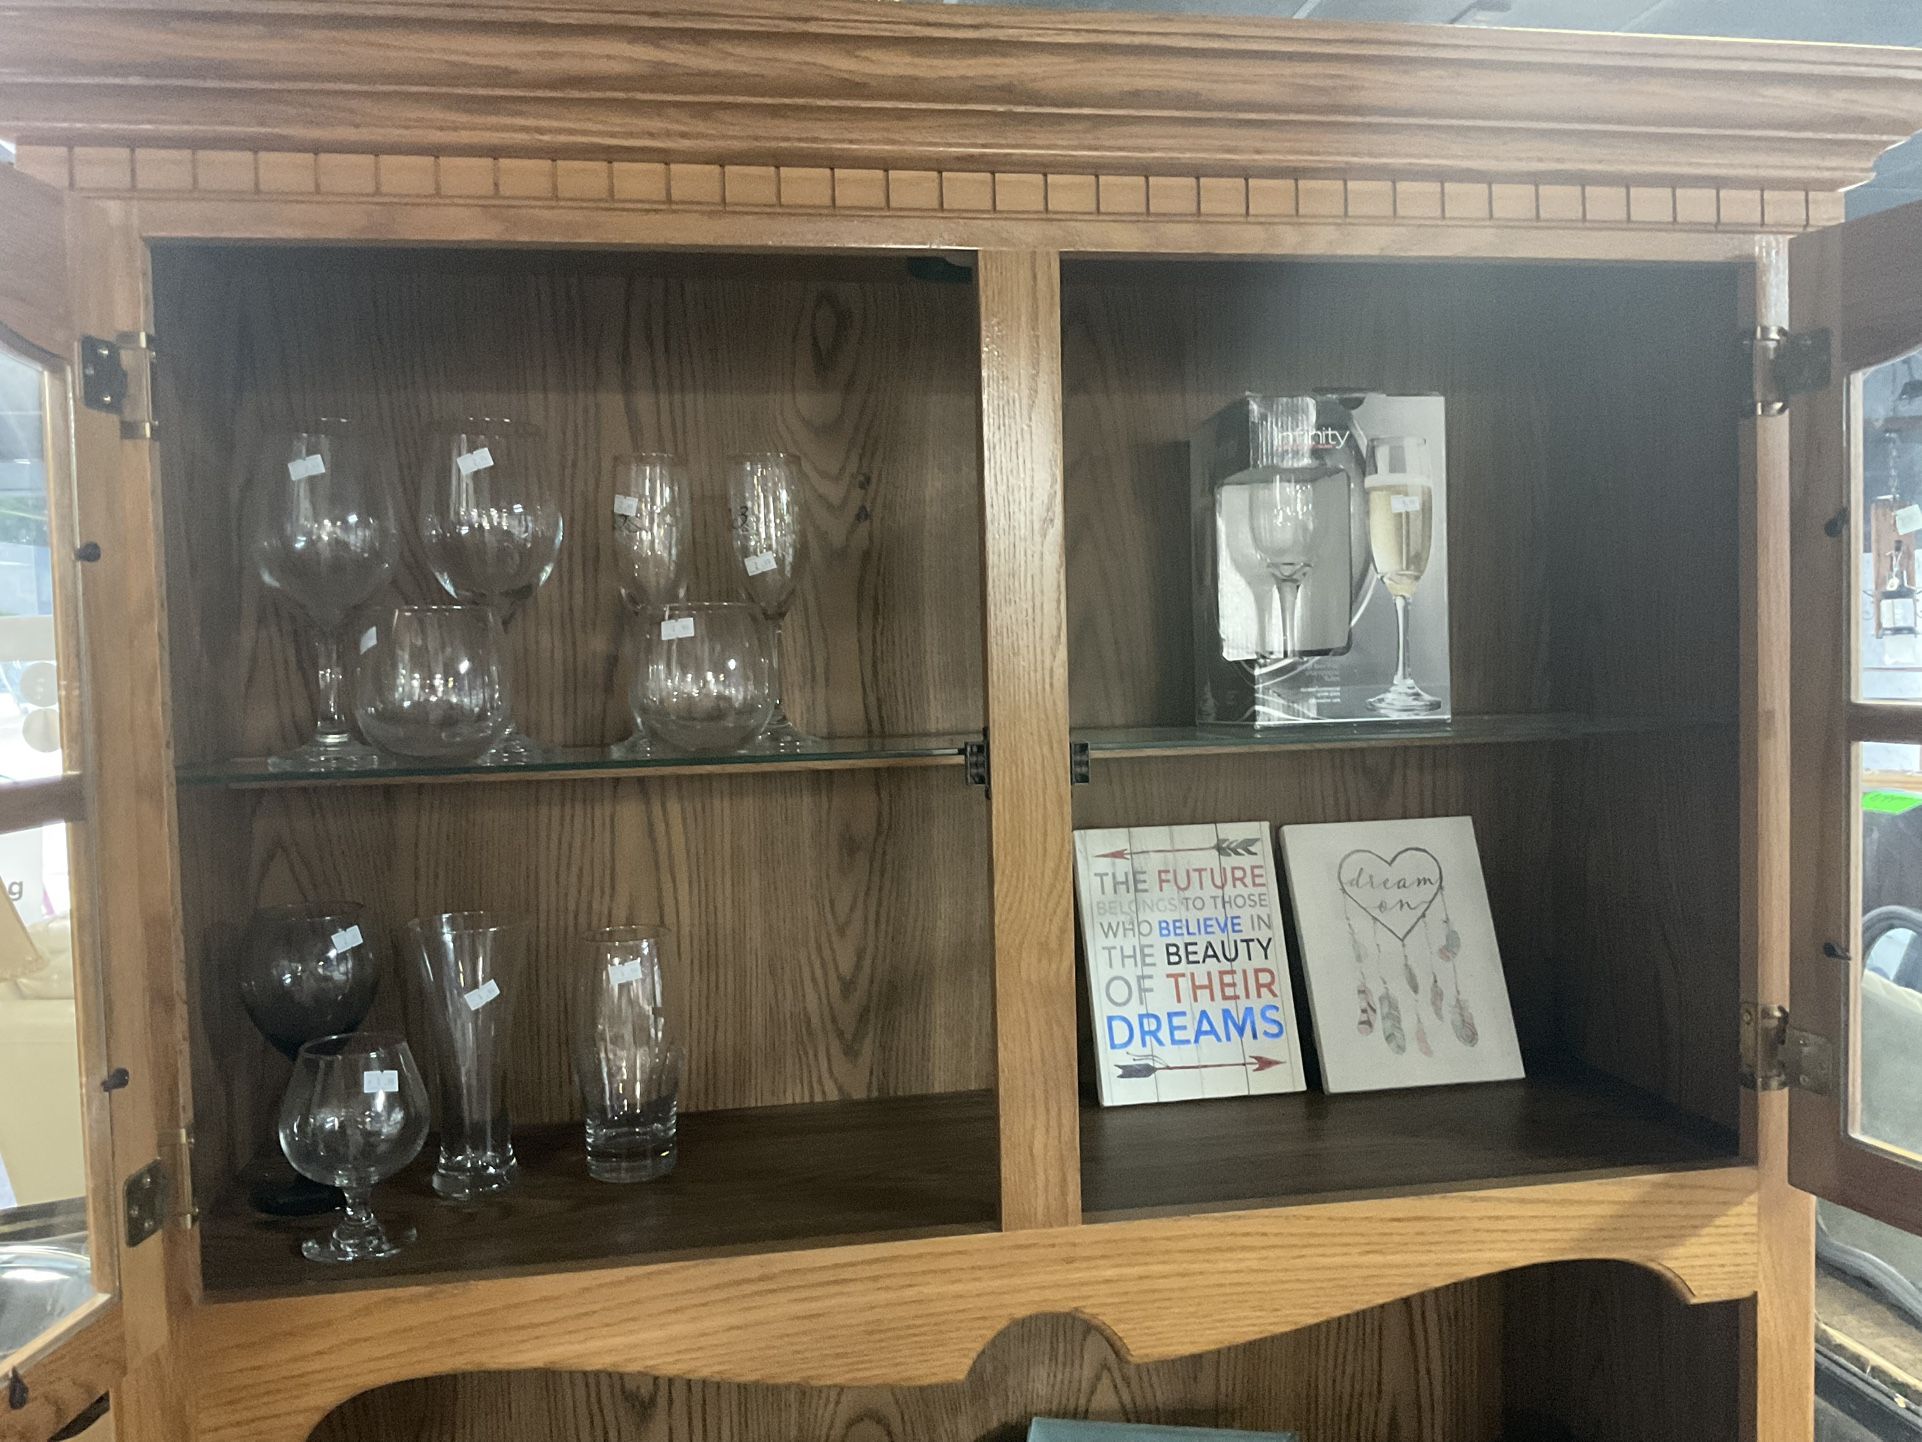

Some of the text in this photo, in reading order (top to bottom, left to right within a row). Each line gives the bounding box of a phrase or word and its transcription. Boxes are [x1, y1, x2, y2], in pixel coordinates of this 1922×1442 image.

[1094, 865, 1267, 896] THE FUTURE
[1349, 867, 1436, 890] dream
[1183, 896, 1206, 911] TO
[1210, 893, 1269, 909] THOSE
[1375, 898, 1419, 912] on
[1100, 913, 1273, 939] WHO BELIEVE IN
[1102, 937, 1273, 969] THE BEAUTY
[1105, 968, 1279, 1007] OF THEIR
[1106, 1004, 1285, 1050] DREAMS
